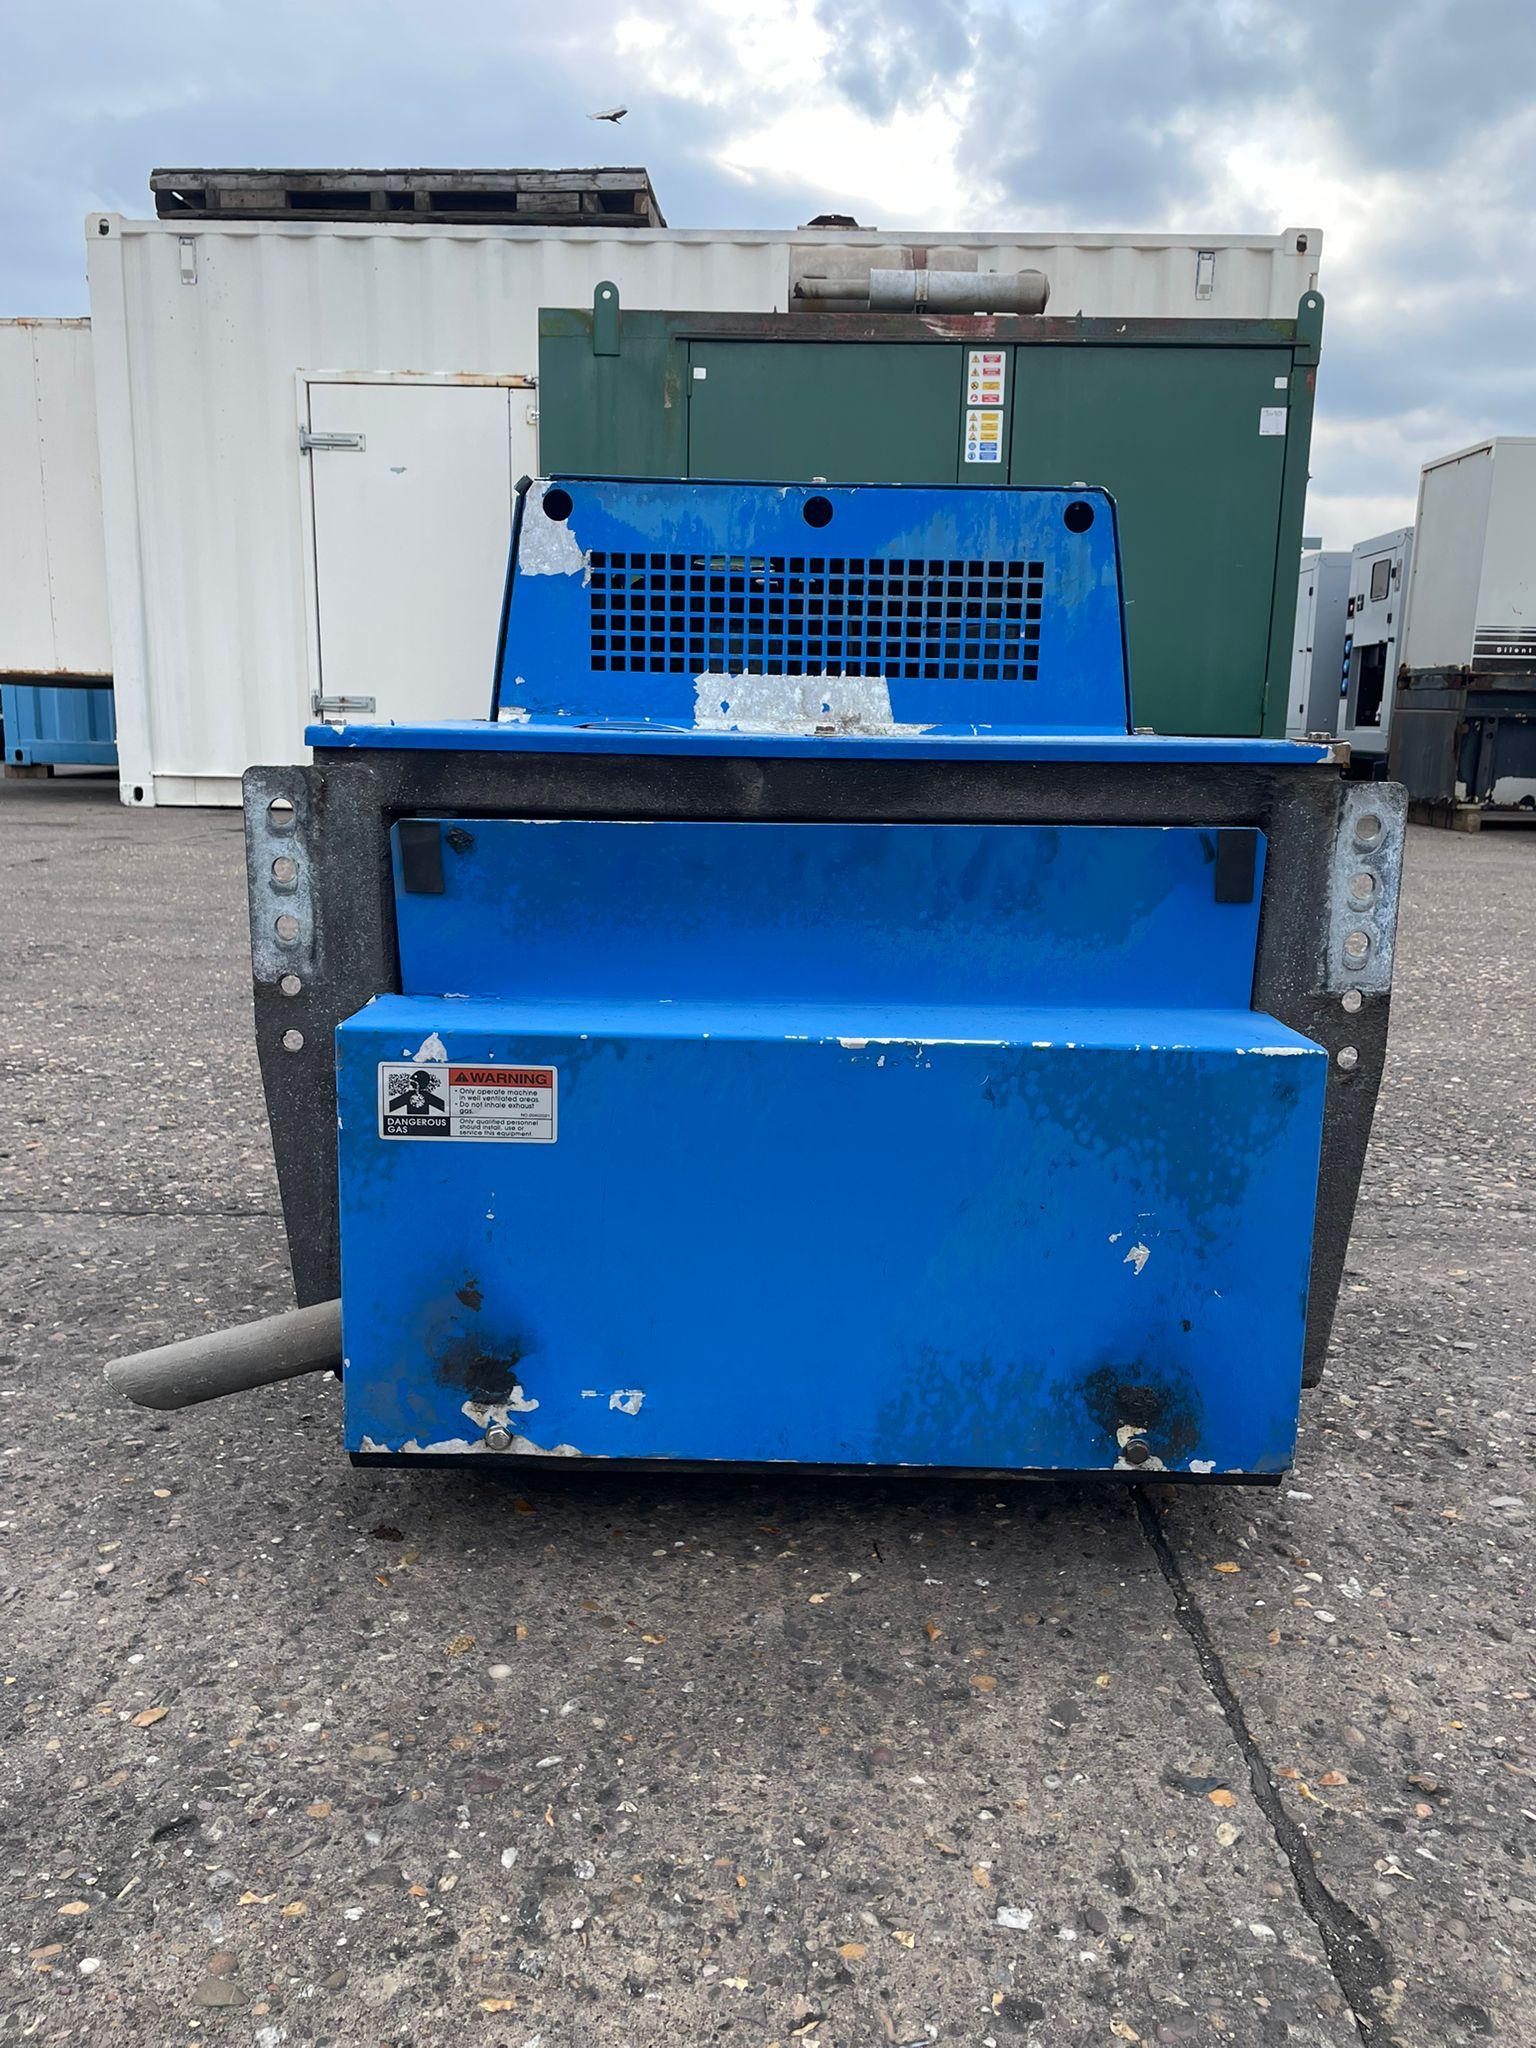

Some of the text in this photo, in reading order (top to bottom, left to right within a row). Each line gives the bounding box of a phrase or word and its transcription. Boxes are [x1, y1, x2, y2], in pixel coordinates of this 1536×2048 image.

[469, 1072, 548, 1084] WARNING
[459, 1088, 475, 1096] Only
[477, 1089, 505, 1097] operate
[387, 1118, 447, 1127] DANGEROUS
[387, 1126, 408, 1134] GAS
